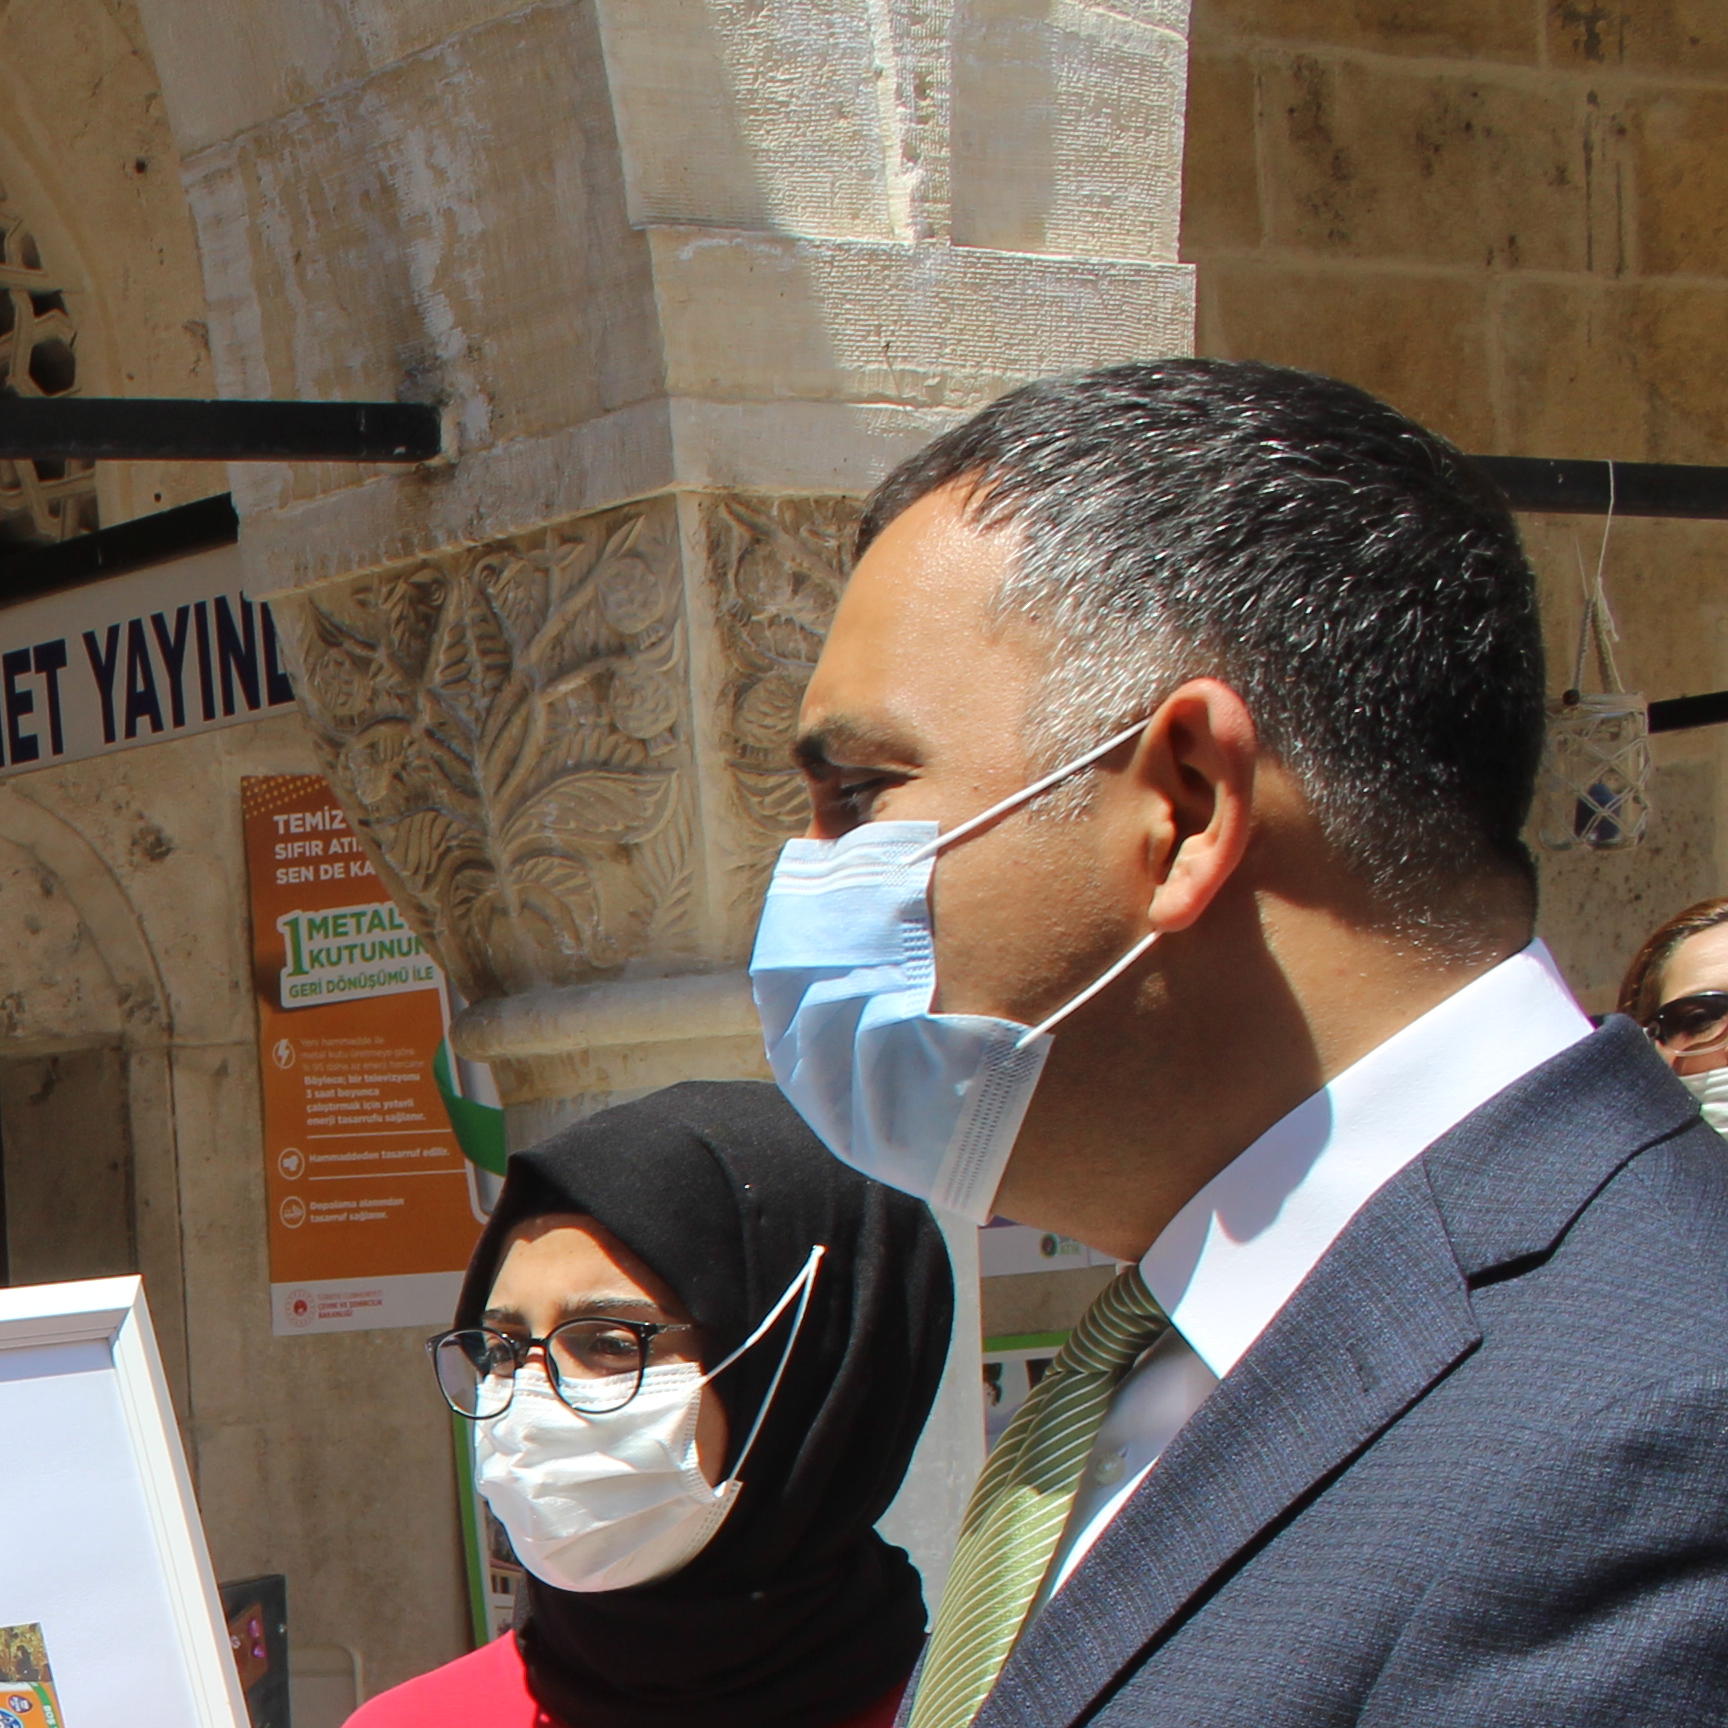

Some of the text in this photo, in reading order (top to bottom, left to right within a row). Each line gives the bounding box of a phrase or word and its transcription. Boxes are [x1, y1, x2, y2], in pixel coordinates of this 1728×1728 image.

[273, 806, 346, 834] TEMİZ
[274, 837, 363, 860] SIFIR ATI
[276, 865, 314, 884] SEN
[319, 863, 344, 880] DE
[282, 906, 404, 978] 1 METAL
[289, 965, 434, 998] GERİ DÖNÜŞÜMÜ İLE
